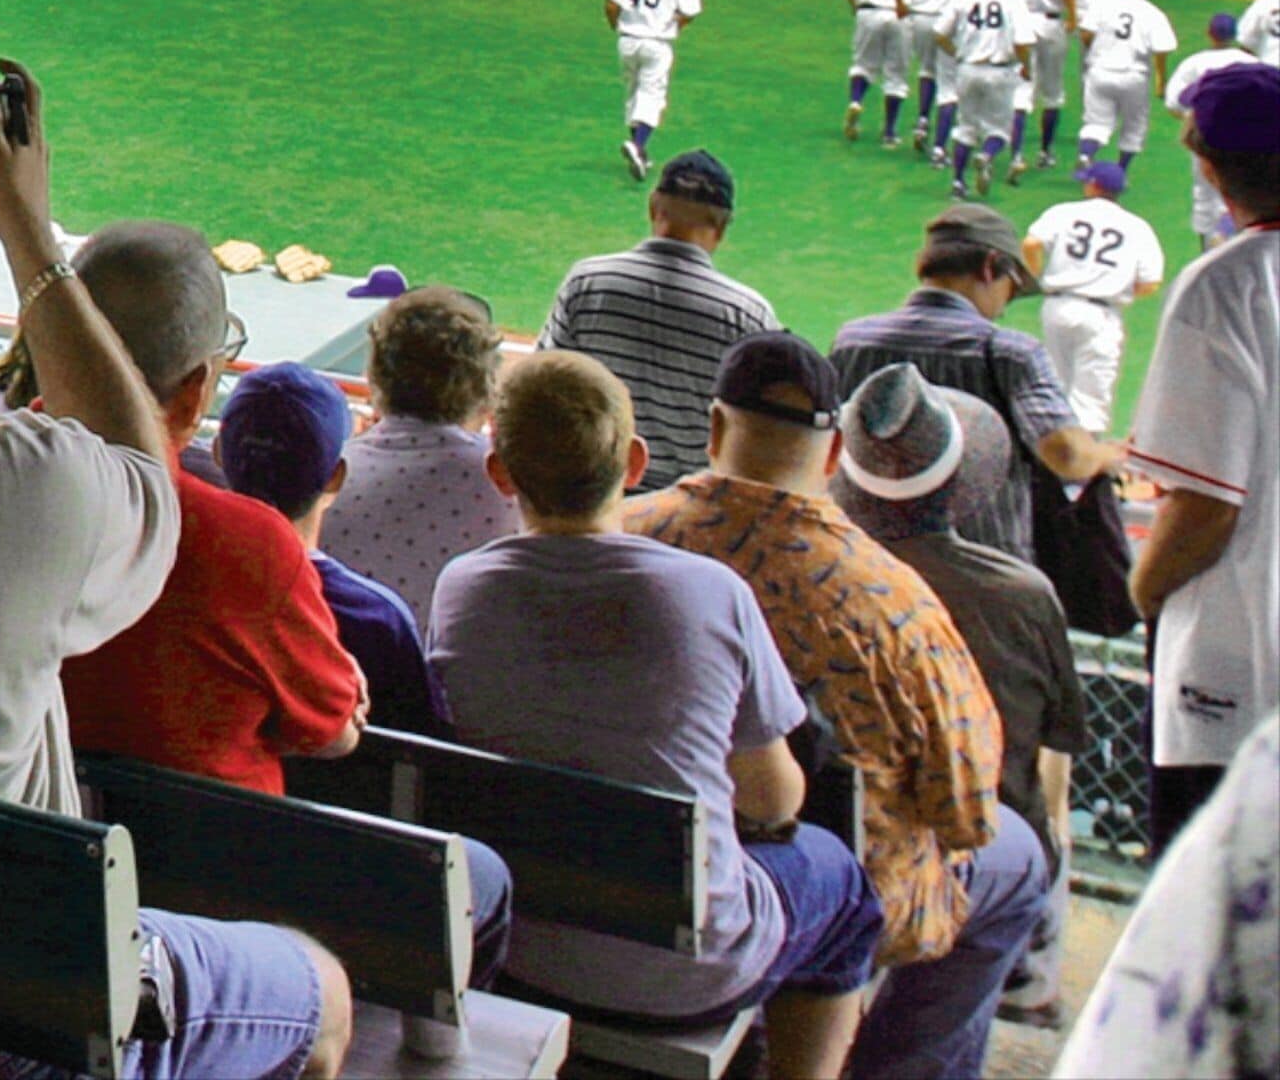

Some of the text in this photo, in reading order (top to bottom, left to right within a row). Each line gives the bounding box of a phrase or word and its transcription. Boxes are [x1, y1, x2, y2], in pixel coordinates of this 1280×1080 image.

[967, 1, 1003, 29] 48
[1115, 13, 1133, 39] 3
[1066, 220, 1123, 267] 32
